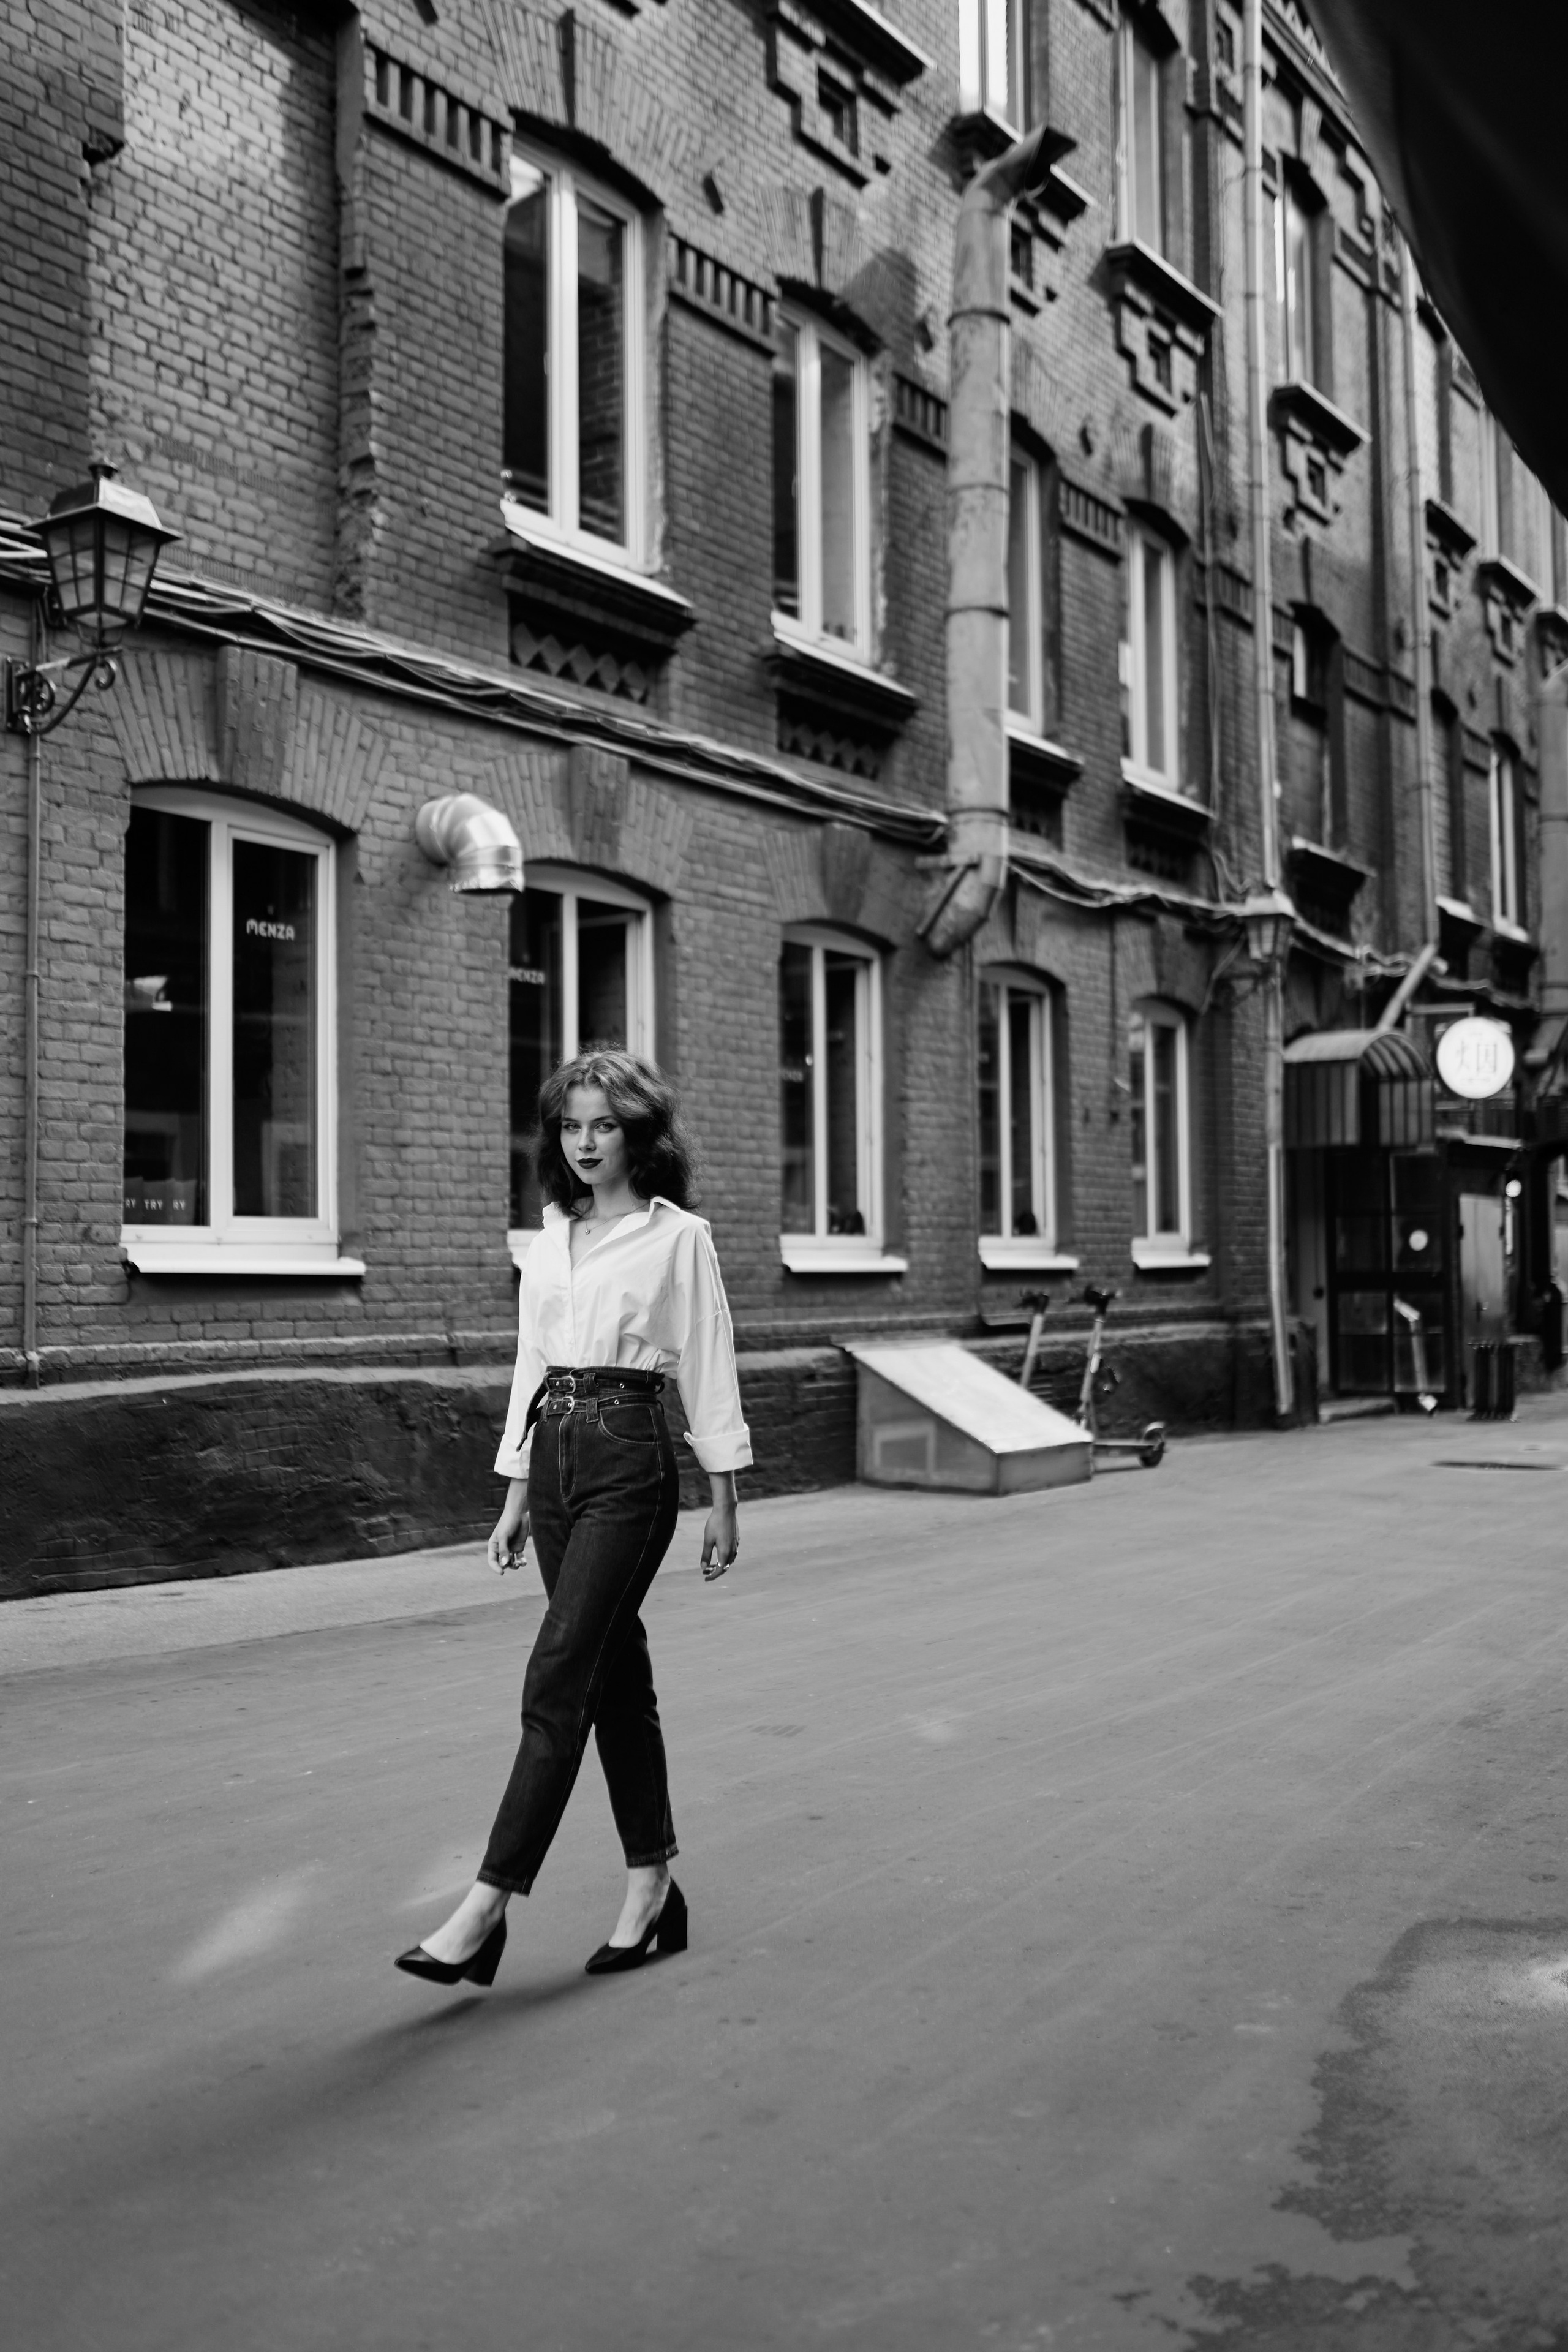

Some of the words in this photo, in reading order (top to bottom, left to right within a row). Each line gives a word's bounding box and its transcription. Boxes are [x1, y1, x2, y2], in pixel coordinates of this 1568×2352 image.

[246, 918, 295, 941] MENZA
[125, 1198, 136, 1208] RY
[144, 1199, 163, 1210] TRY
[172, 1199, 186, 1210] RY
